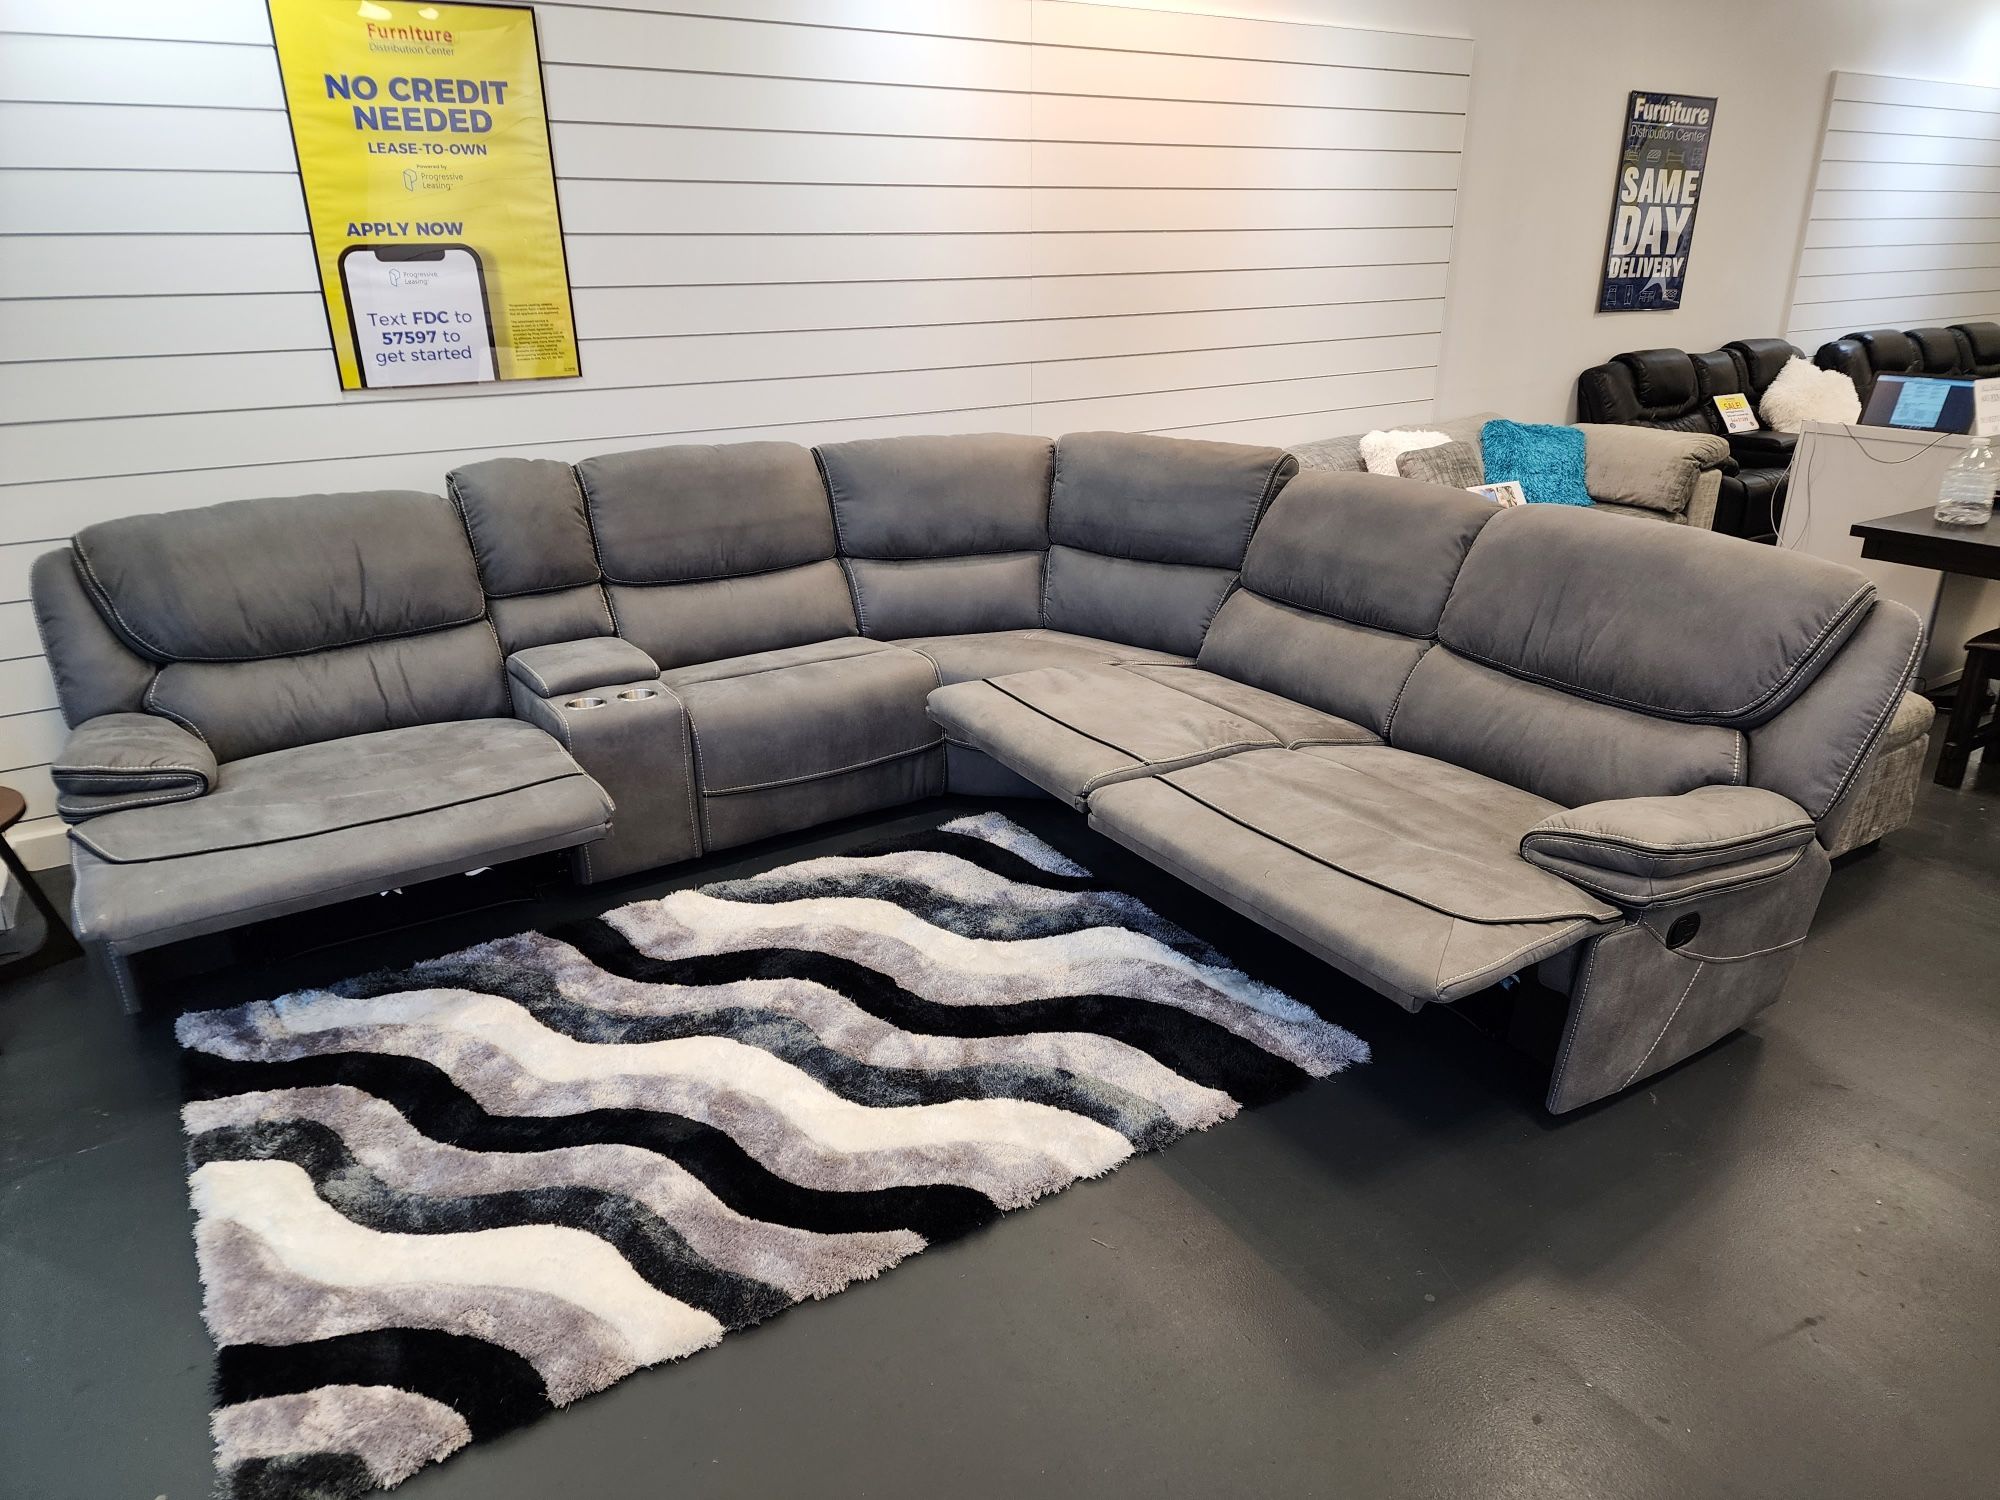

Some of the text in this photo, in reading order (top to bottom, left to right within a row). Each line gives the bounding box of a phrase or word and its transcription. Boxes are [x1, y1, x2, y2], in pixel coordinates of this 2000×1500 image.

[367, 22, 453, 43] Furniture
[369, 42, 454, 56] Distribution Center
[324, 74, 508, 105] NO CREDIT
[353, 106, 493, 133] NEEDED
[1634, 98, 1709, 125] Furniture
[1630, 124, 1707, 143] Distribution Center
[368, 142, 487, 156] LEASE-TO-OWN
[421, 173, 464, 182] Progressive
[1621, 166, 1699, 205] SAME
[347, 222, 463, 237] APPLY NOW
[1613, 205, 1692, 255] DAY
[1608, 257, 1685, 279] DELIVERY
[367, 310, 473, 326] Text FDC to
[382, 330, 461, 345] 57597 to
[375, 345, 473, 366] get started
